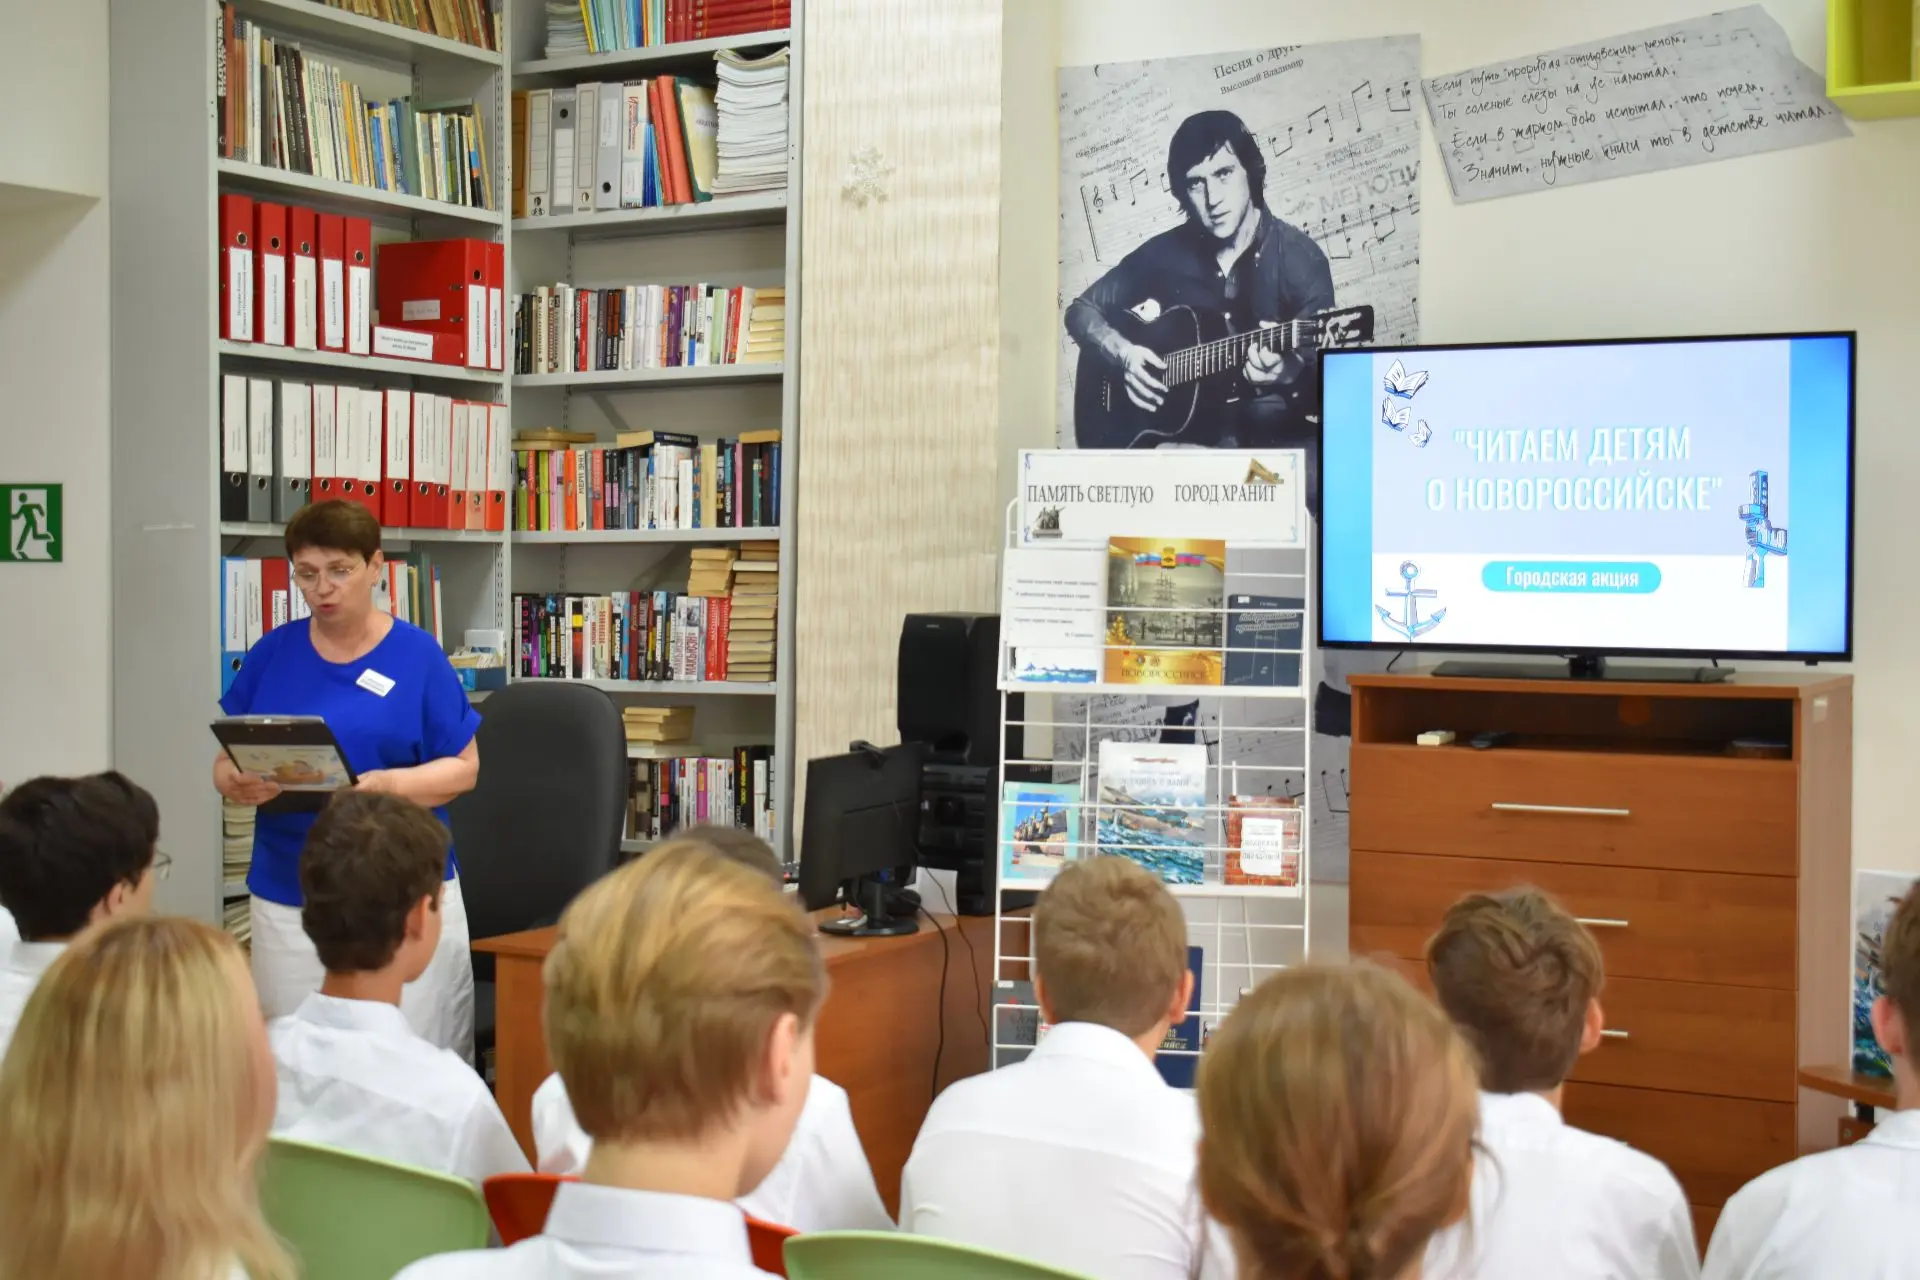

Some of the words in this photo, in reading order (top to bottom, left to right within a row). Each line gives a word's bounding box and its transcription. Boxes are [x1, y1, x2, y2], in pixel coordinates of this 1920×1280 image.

[1213, 57, 1254, 79] Песня
[1256, 53, 1264, 64] о
[1219, 73, 1262, 95] Высоцкий
[1262, 58, 1304, 79] Владимир
[1431, 79, 1462, 93] Если
[1438, 104, 1457, 119] Ты
[1465, 97, 1513, 115] соленые
[1521, 88, 1557, 115] слезы
[1566, 83, 1580, 95] на
[1585, 76, 1605, 104] ус
[1452, 130, 1487, 149] Если
[1496, 127, 1505, 142] в
[1511, 119, 1563, 140] жарком
[1566, 105, 1596, 127] бою
[1681, 91, 1708, 104] что
[1540, 149, 1594, 185] нужные
[1602, 139, 1640, 160] книги
[1650, 135, 1673, 148] ты
[1682, 127, 1692, 143] в
[1702, 115, 1768, 153] детстве
[1453, 427, 1578, 464] "ЧИТАЕМ
[1588, 426, 1691, 467] ДЕТЯМ
[1027, 484, 1084, 503] ПАМЯТЬ
[1087, 485, 1154, 507] СВЕТЛУЮ
[1174, 484, 1219, 504] ГОРОД
[1222, 484, 1277, 503] ХРАНИТ
[1426, 478, 1446, 511] О
[1454, 470, 1723, 511] НОВОРОССИЙСКЕ"
[1506, 565, 1587, 591] Городская
[1591, 570, 1639, 591] акция
